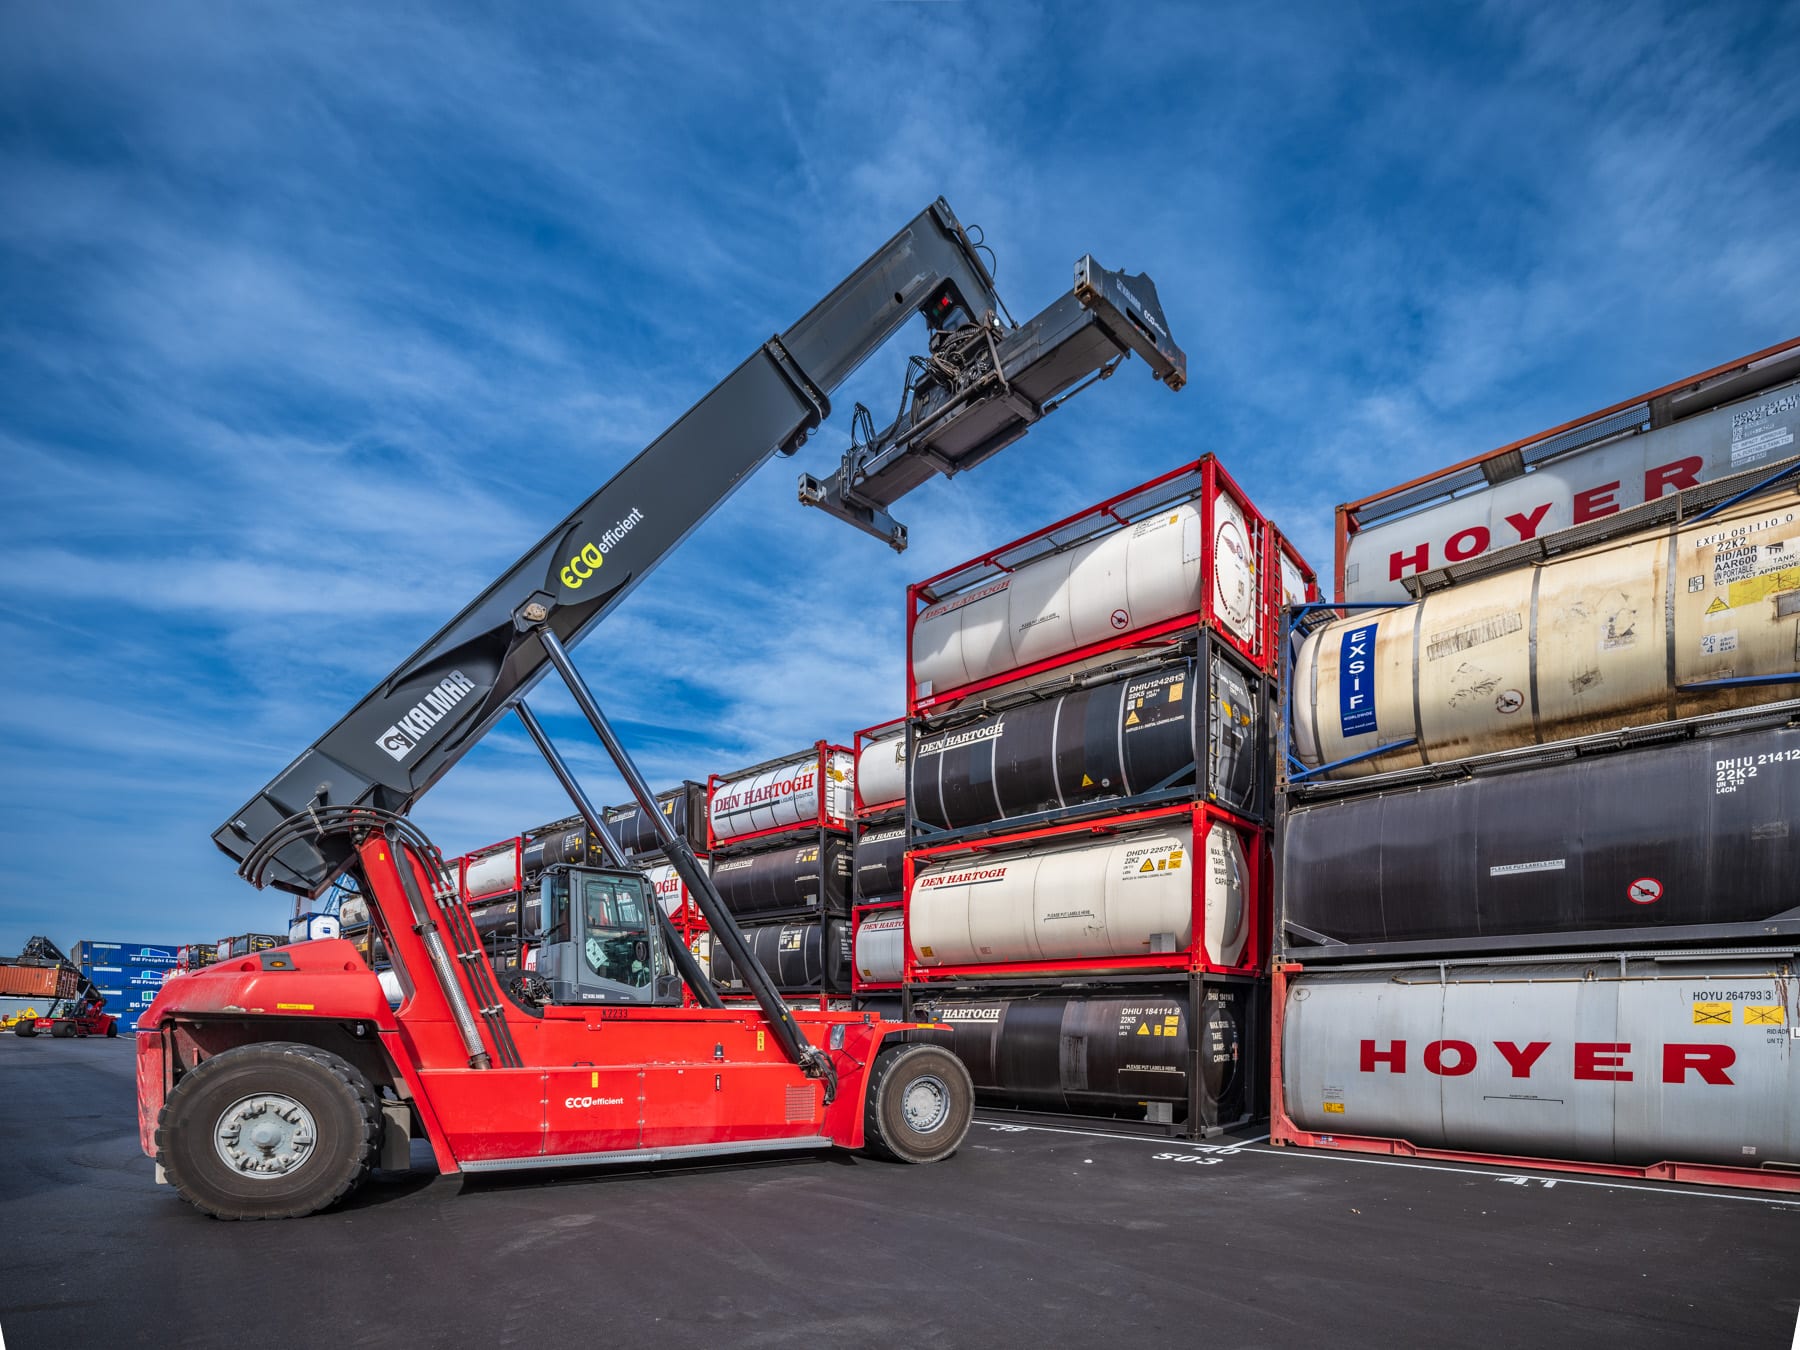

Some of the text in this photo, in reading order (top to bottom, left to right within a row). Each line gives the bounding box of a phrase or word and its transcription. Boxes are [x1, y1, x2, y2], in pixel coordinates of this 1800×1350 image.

[1734, 407, 1761, 421] HOYU
[1734, 414, 1761, 428] 22K2
[1766, 401, 1796, 417] L4CH
[1389, 455, 1703, 582] HOYER
[598, 507, 645, 554] efficient
[1696, 533, 1725, 548] EXFU
[1717, 537, 1746, 552] 22K2
[1715, 545, 1757, 563] RID/ADR
[1773, 554, 1795, 563] TANK
[1714, 554, 1757, 572] AAR600
[1723, 564, 1753, 579] PORTABLE
[1726, 572, 1756, 584] IMPACT
[1758, 560, 1800, 576] APPROVE
[1702, 635, 1716, 647] 26
[1706, 645, 1713, 653] 4
[1348, 630, 1367, 710] EXSIF
[398, 669, 476, 741] KALMAR
[1344, 711, 1373, 721] WORLDWIDE
[919, 722, 1006, 754] DEN HARTOGH
[1716, 749, 1800, 771] DHIU 21412
[1716, 766, 1757, 782] 22K2
[1730, 778, 1745, 786] T12
[714, 773, 815, 813] DEN HARTOGH
[1716, 786, 1737, 794] L4CH
[861, 834, 876, 843] DEN
[1126, 849, 1149, 857] DHDU
[1150, 844, 1178, 854] 225757
[920, 868, 1007, 888] DEN HARTOGH
[1693, 990, 1773, 1001] HOYU 264793 3
[942, 1009, 1001, 1019] HARTOGH
[1122, 1007, 1142, 1015] DHIU
[1145, 1007, 1172, 1015] 184114
[1120, 1016, 1136, 1024] 22K5
[1359, 1039, 1737, 1086] HOYER
[592, 1097, 624, 1106] efficient
[1152, 1152, 1224, 1165] 503
[1495, 1176, 1558, 1188] 41
